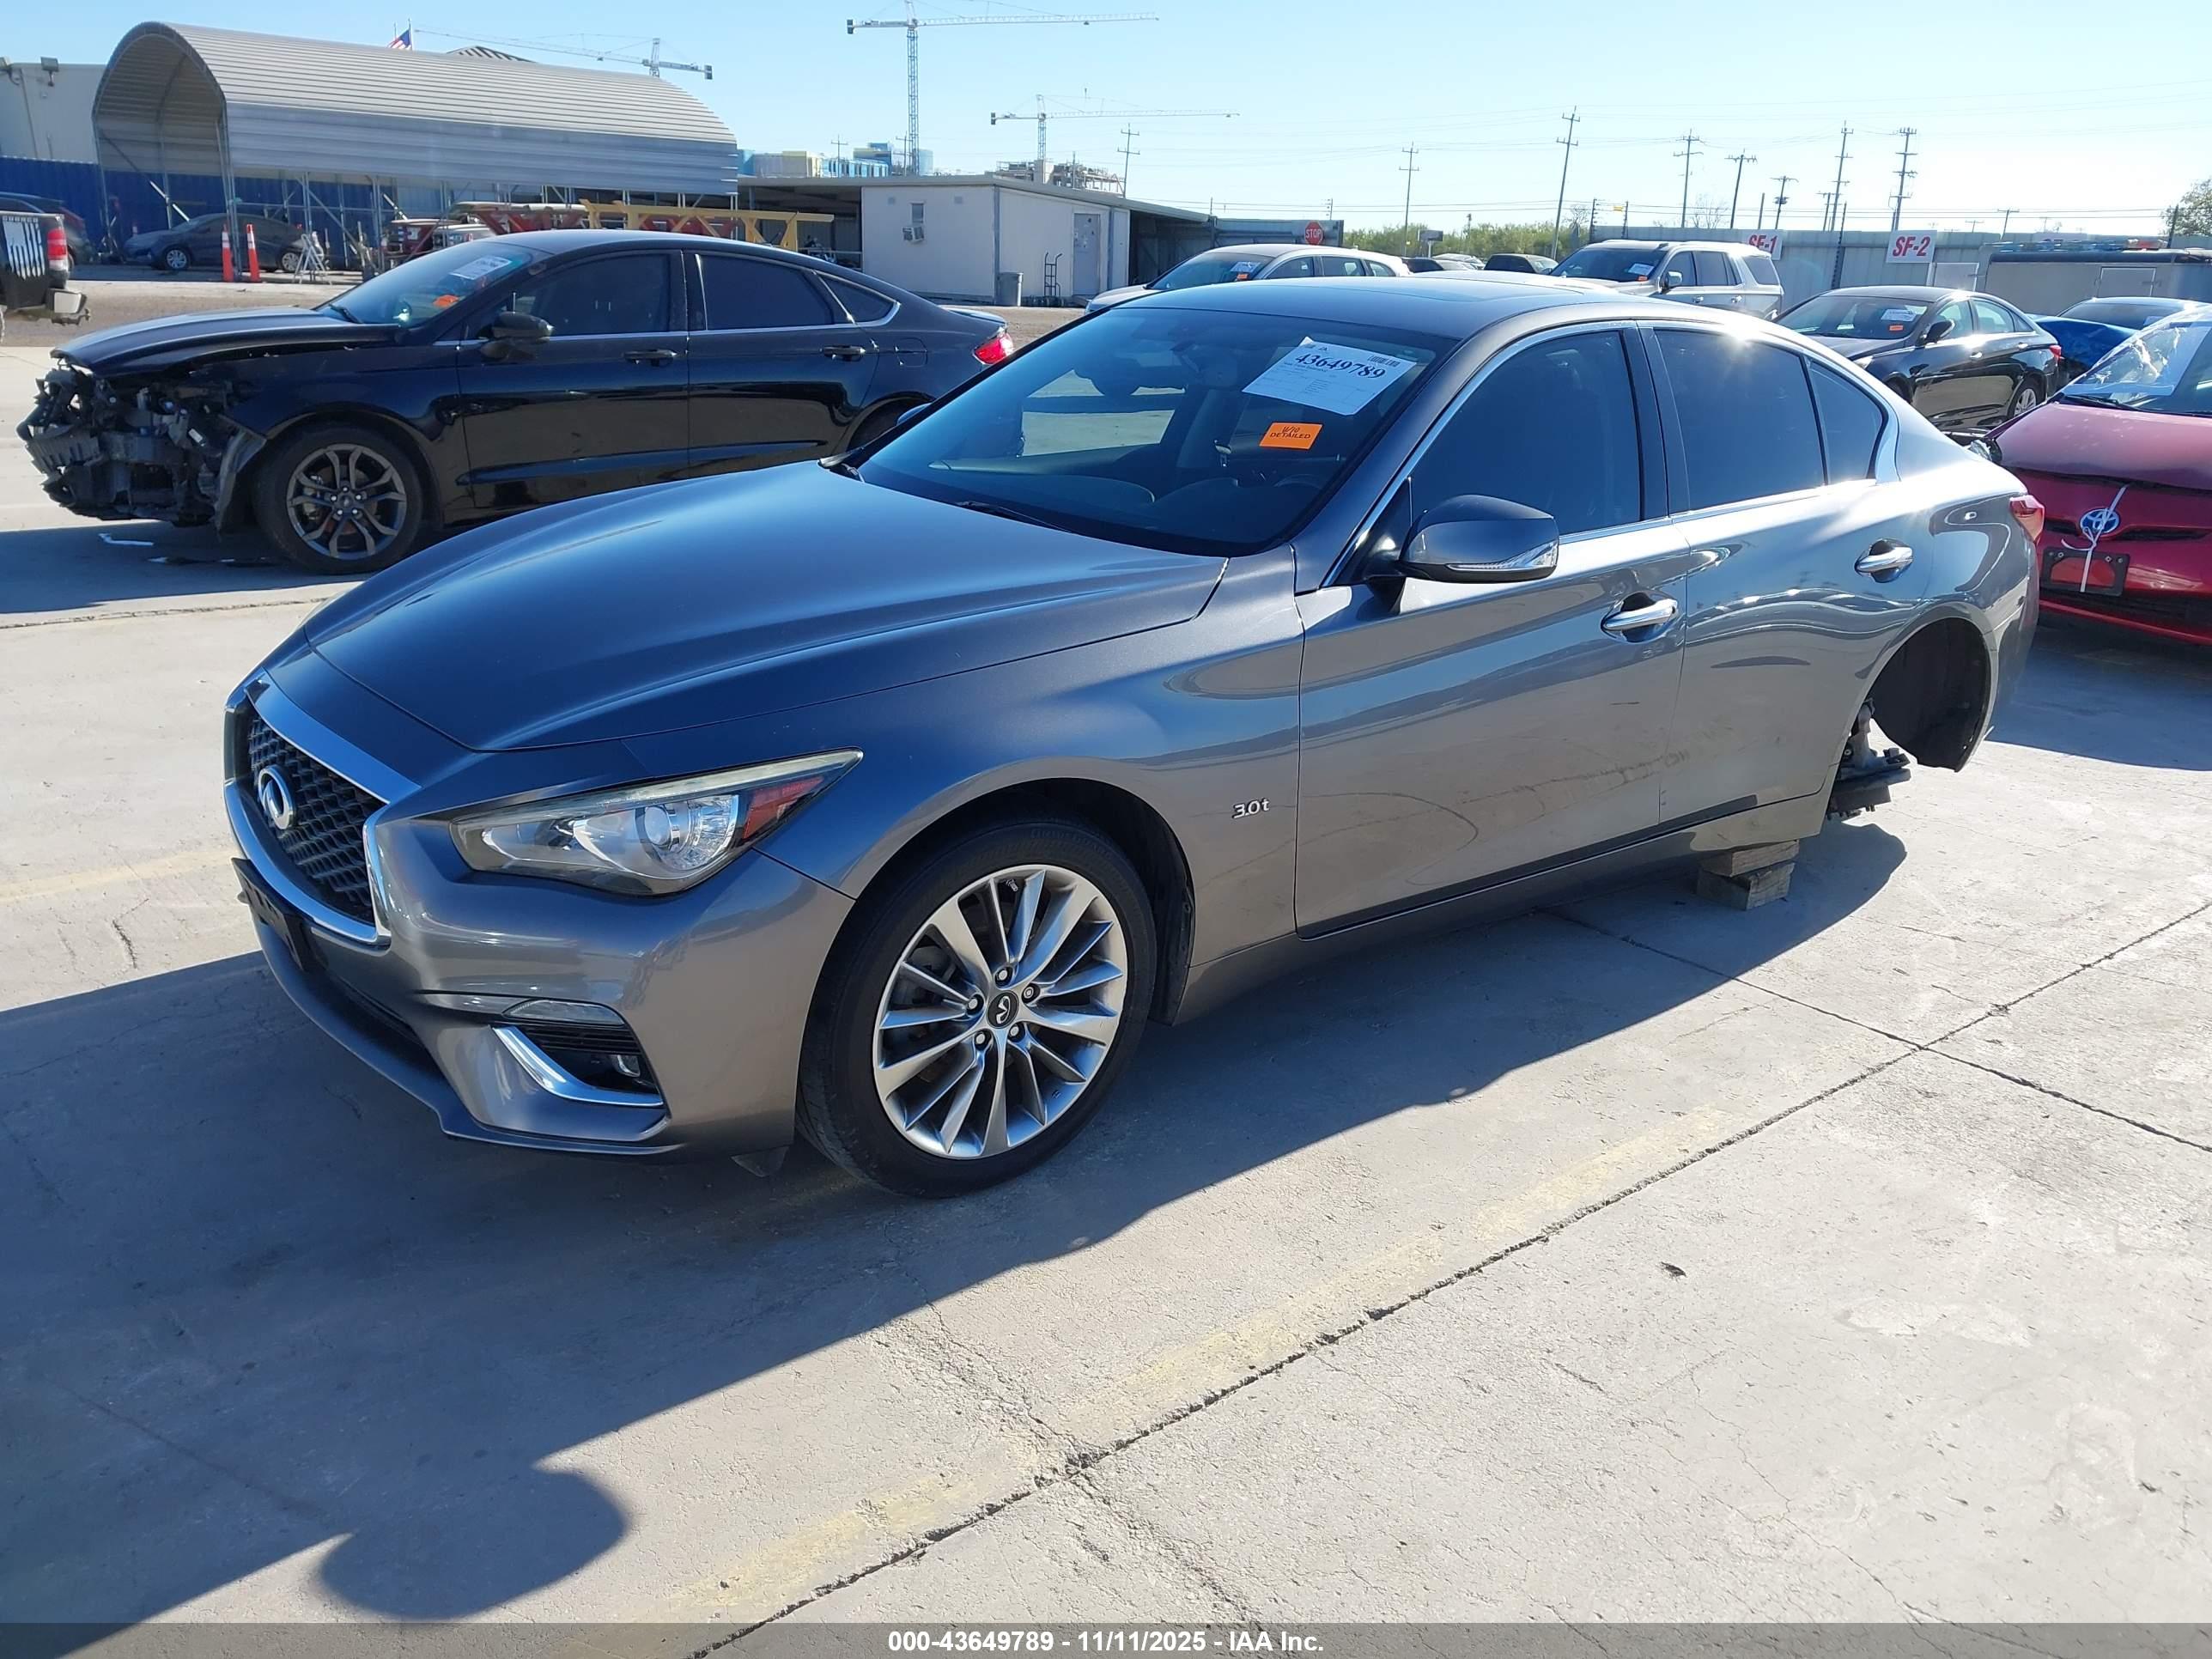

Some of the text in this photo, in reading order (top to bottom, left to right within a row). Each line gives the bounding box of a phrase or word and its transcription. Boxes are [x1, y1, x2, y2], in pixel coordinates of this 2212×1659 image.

[1305, 228, 1322, 239] STOP
[1892, 235, 1931, 257] SF-2
[1295, 353, 1386, 379] 43649789
